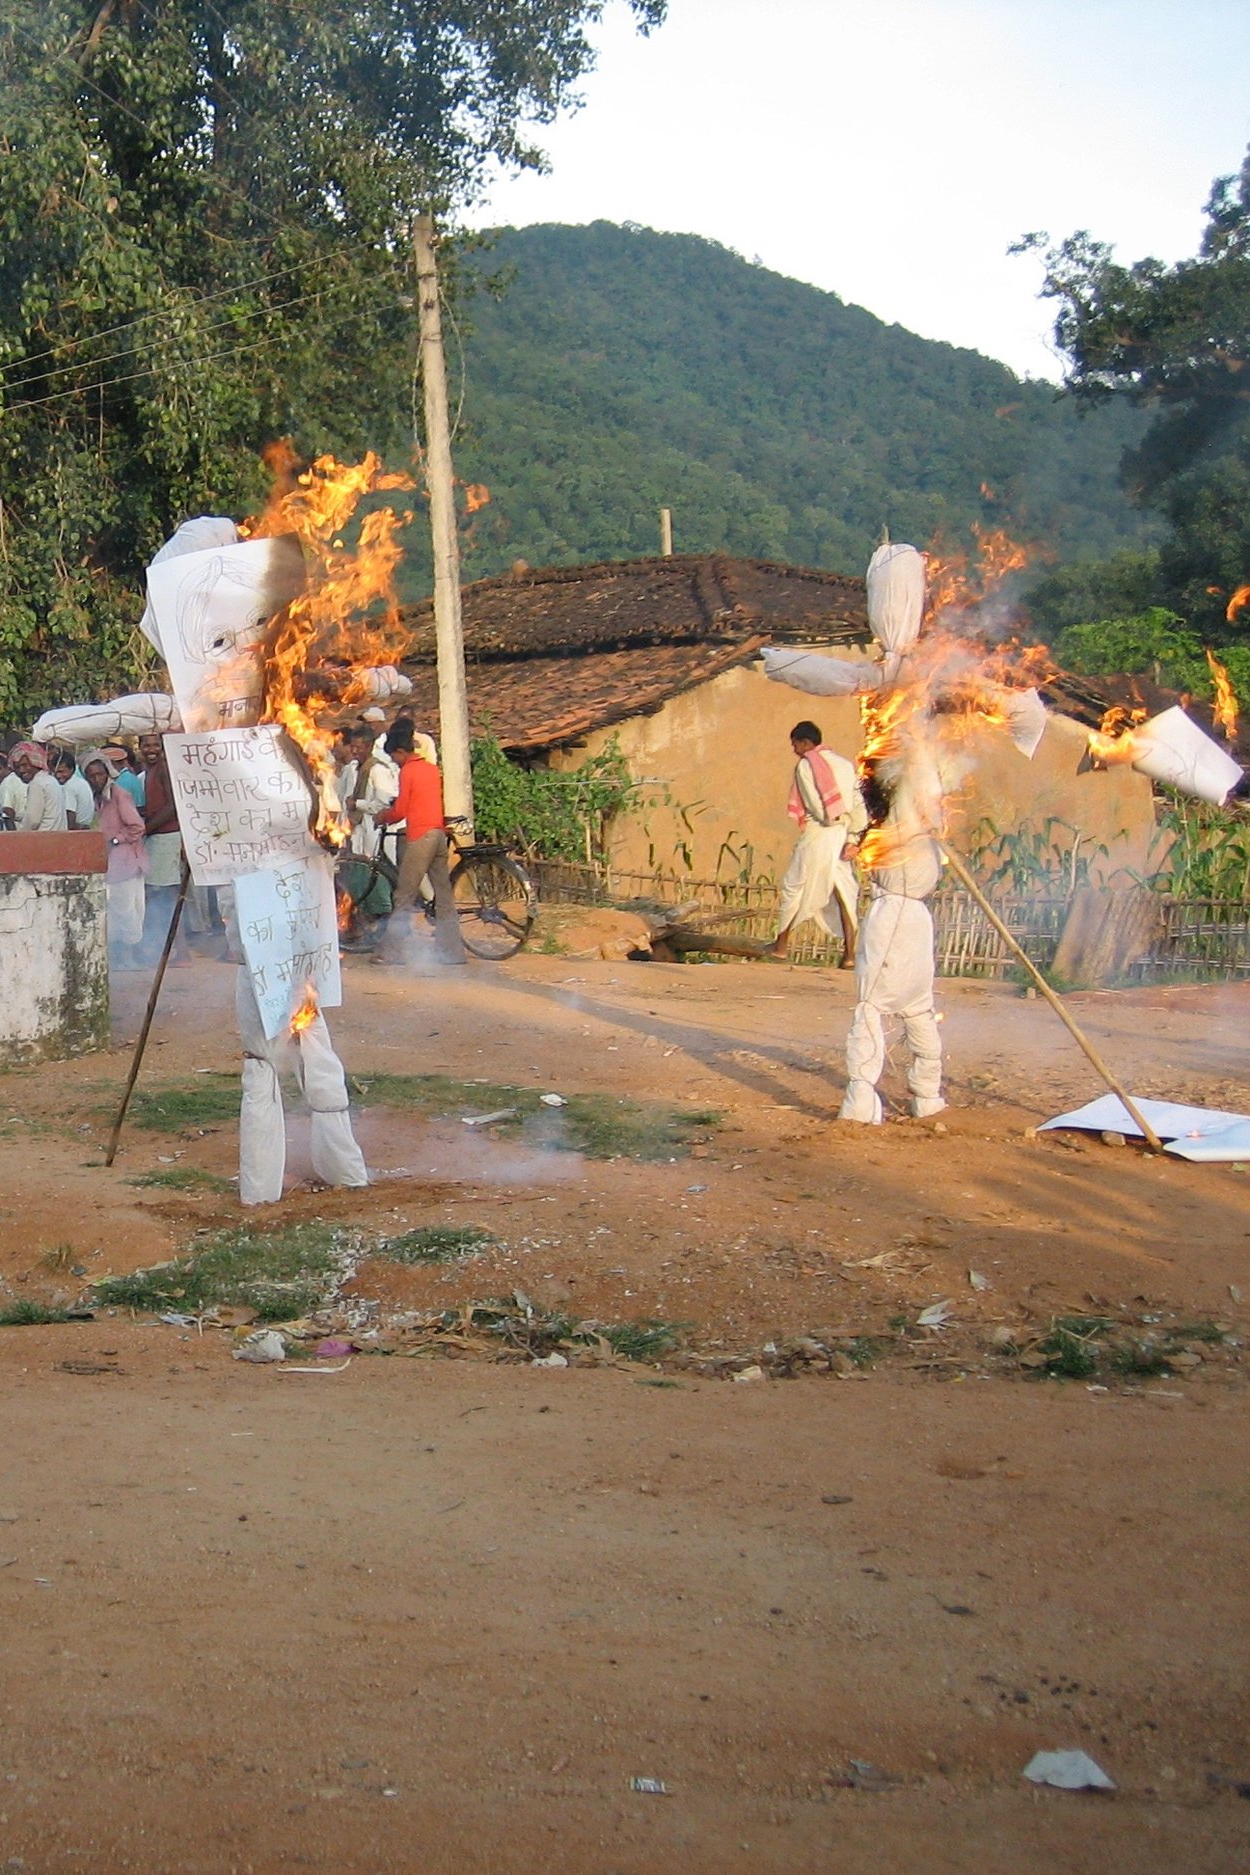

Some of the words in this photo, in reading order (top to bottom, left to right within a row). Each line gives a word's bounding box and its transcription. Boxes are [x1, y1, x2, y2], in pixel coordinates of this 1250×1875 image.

[177, 769, 269, 805] जिम्मेवार
[185, 802, 231, 842] देश
[239, 807, 273, 830] का
[222, 830, 307, 862] मनमोहन
[246, 915, 273, 943] का
